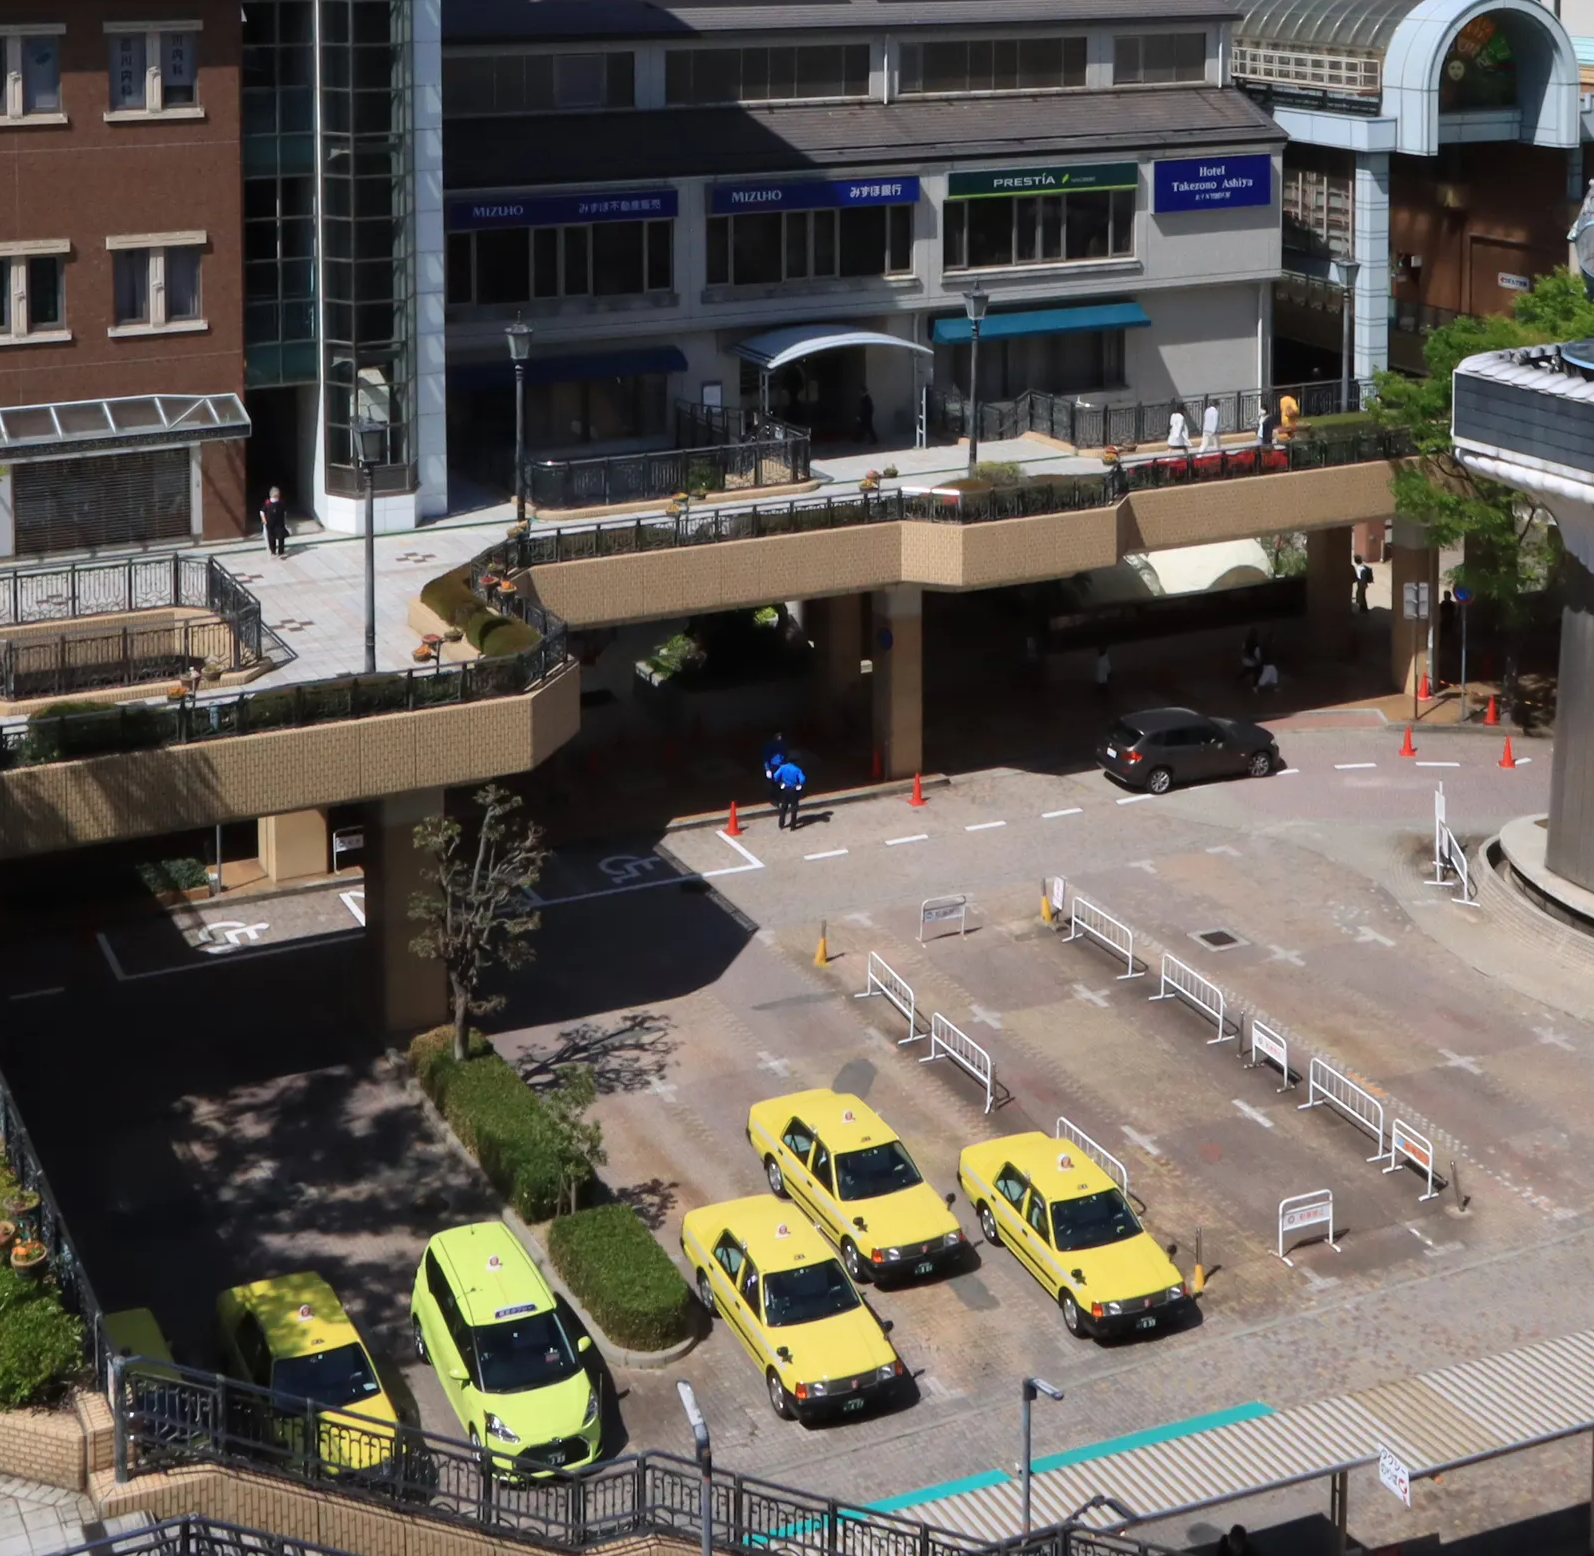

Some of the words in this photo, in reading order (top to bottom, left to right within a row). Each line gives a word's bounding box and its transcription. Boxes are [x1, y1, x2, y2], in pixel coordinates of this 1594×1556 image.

[1199, 165, 1226, 177] Hotel
[849, 184, 902, 198] みずほ銀行
[1172, 180, 1217, 192] Takezono
[1221, 177, 1253, 188] Ashiya
[732, 190, 782, 203] MIZUHO
[473, 205, 524, 217] MIZUHO
